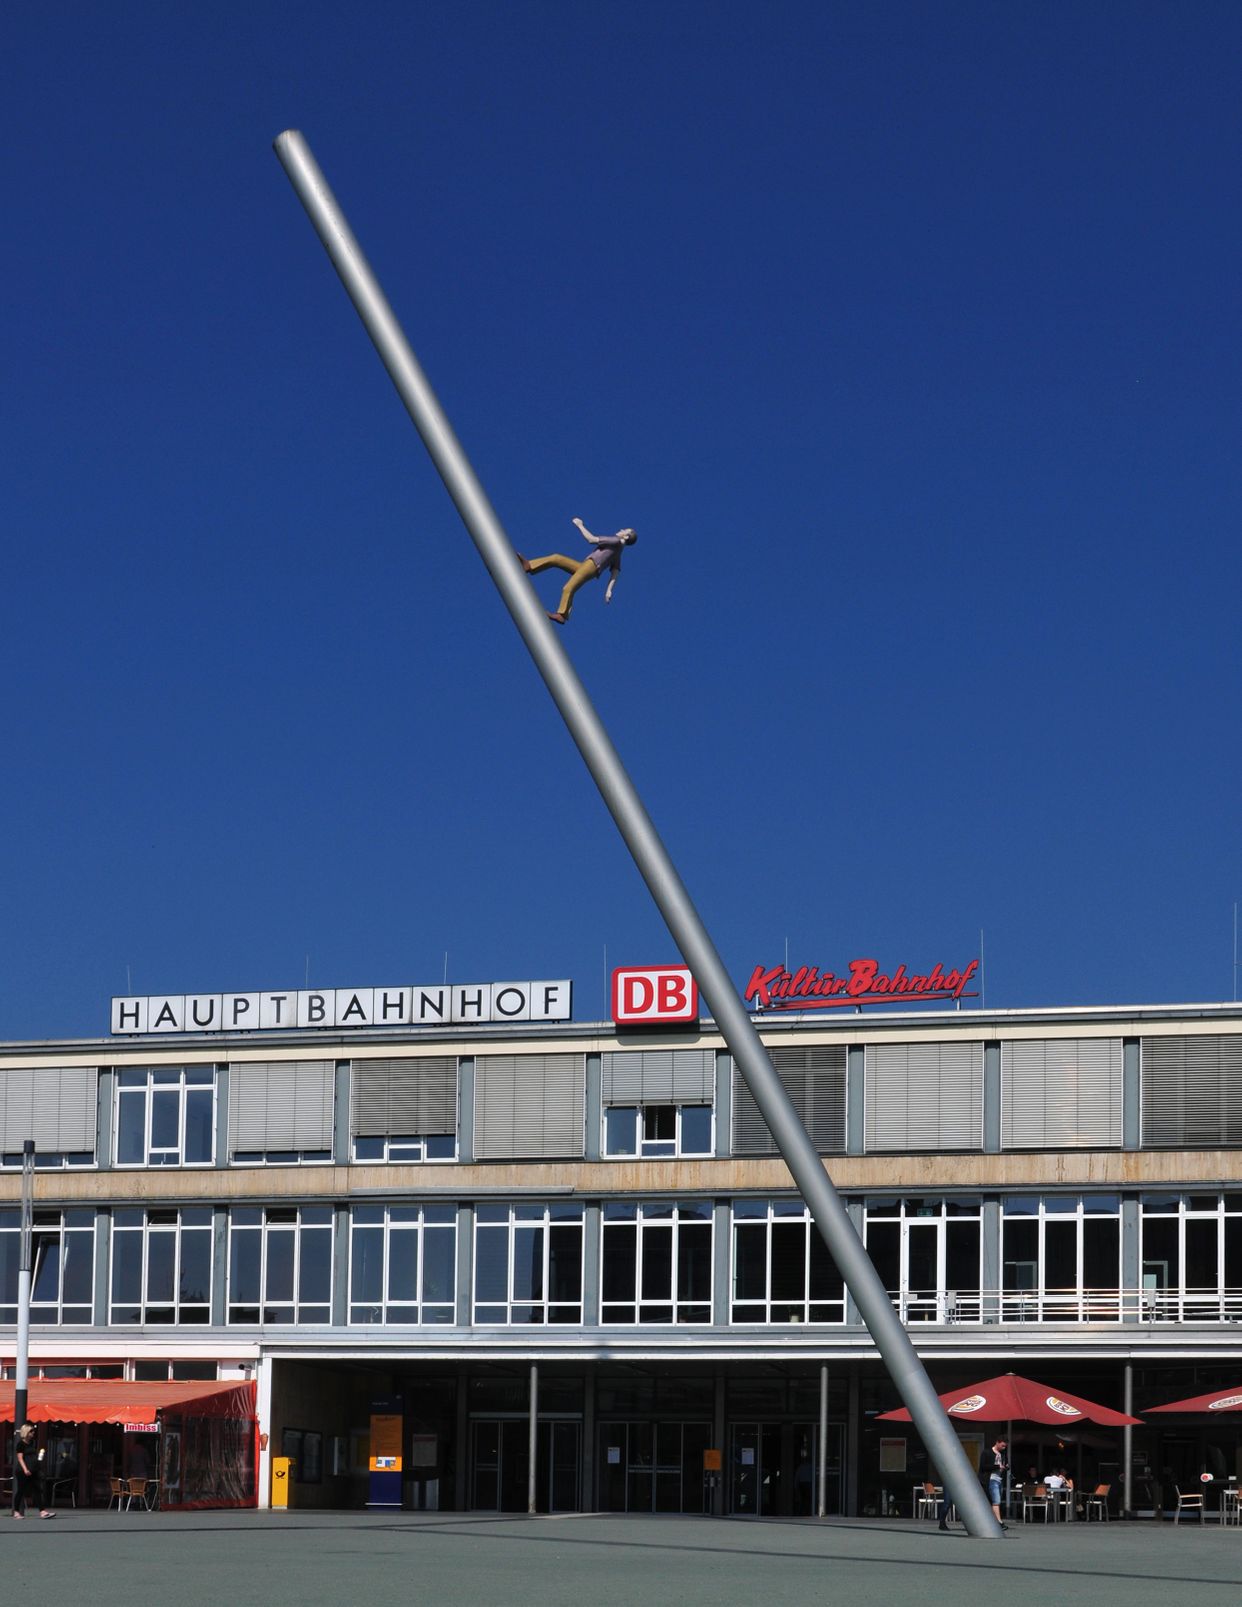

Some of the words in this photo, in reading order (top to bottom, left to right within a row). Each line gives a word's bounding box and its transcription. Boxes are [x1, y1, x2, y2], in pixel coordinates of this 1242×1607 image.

[119, 986, 559, 1029] HAUPTBAHNHOF
[623, 975, 687, 1014] DB
[125, 1423, 157, 1432] Imbiss
